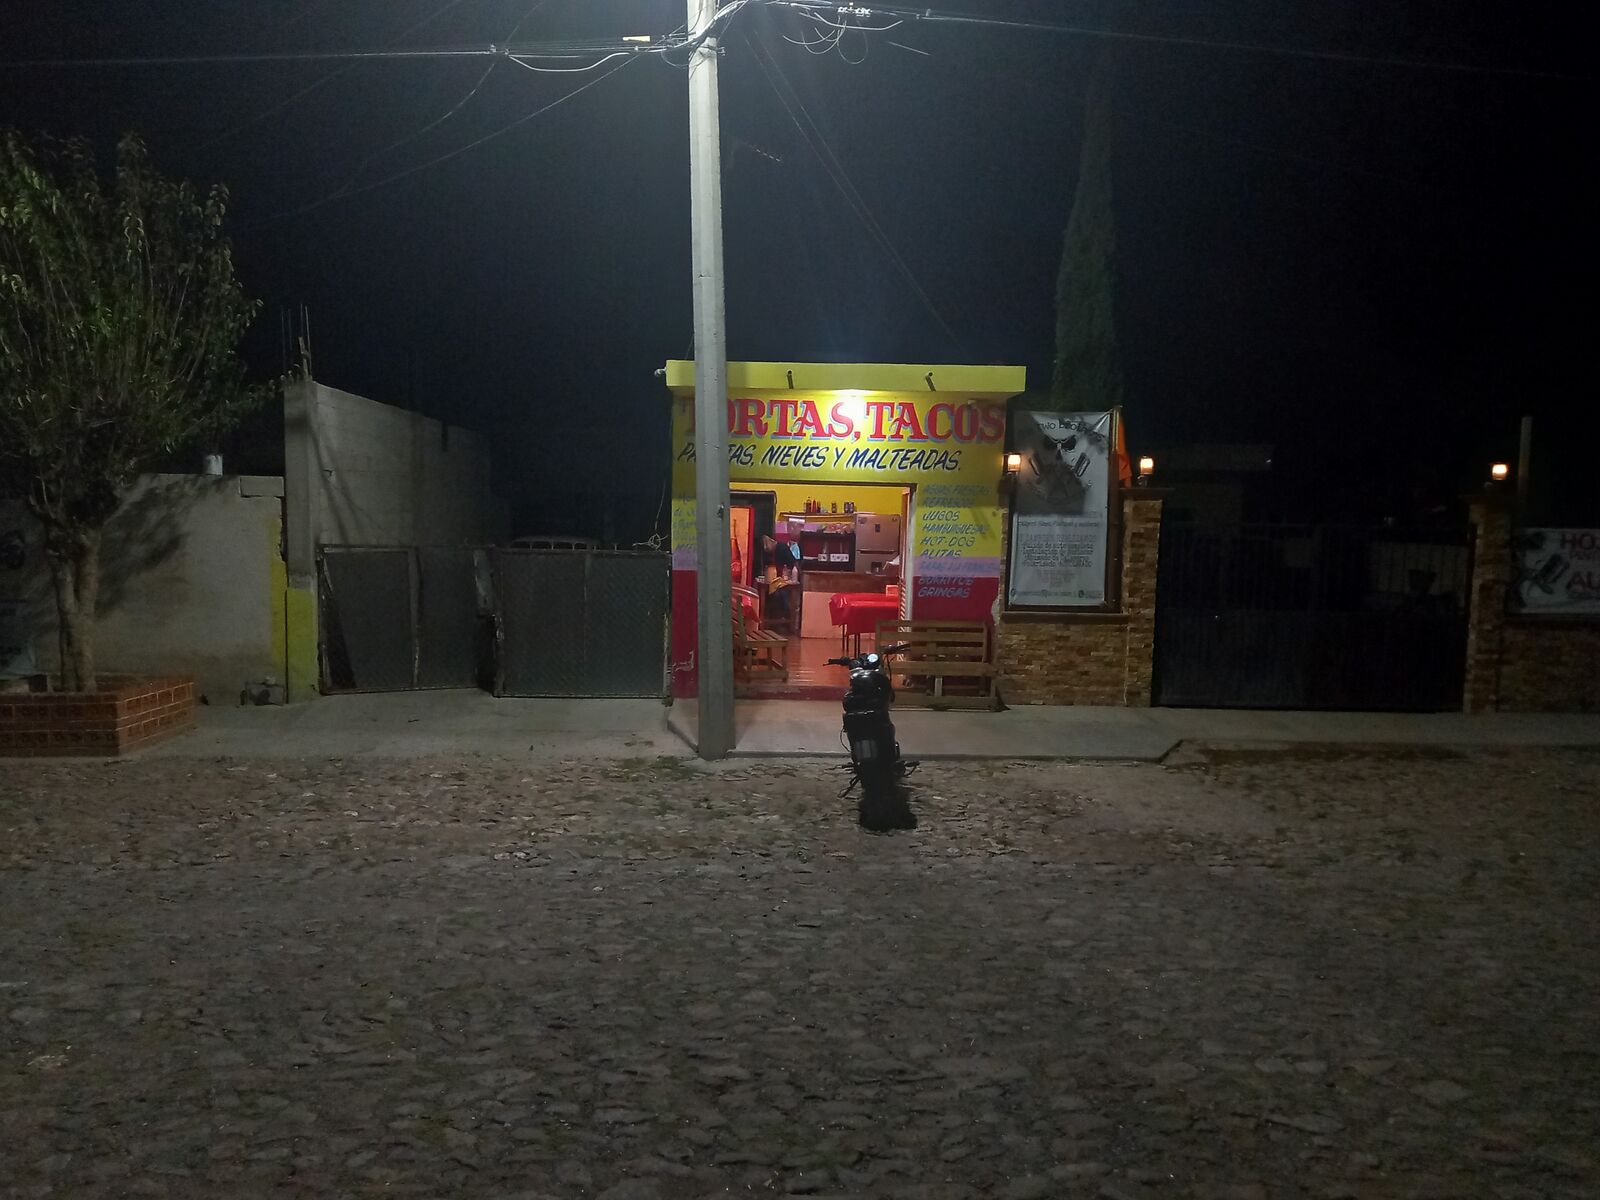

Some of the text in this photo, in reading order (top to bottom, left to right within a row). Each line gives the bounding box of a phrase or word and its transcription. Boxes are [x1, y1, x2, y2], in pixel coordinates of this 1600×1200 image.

[682, 396, 1006, 444] RTAS, TACOS
[677, 442, 962, 472] PATAS, NIEVES Y MALTEADAS.
[922, 510, 960, 521] JUGOS
[920, 536, 975, 547] HOT-DOG
[1560, 533, 1600, 550] HO
[920, 549, 962, 560] ALITAS
[918, 587, 970, 599] GRINGAS
